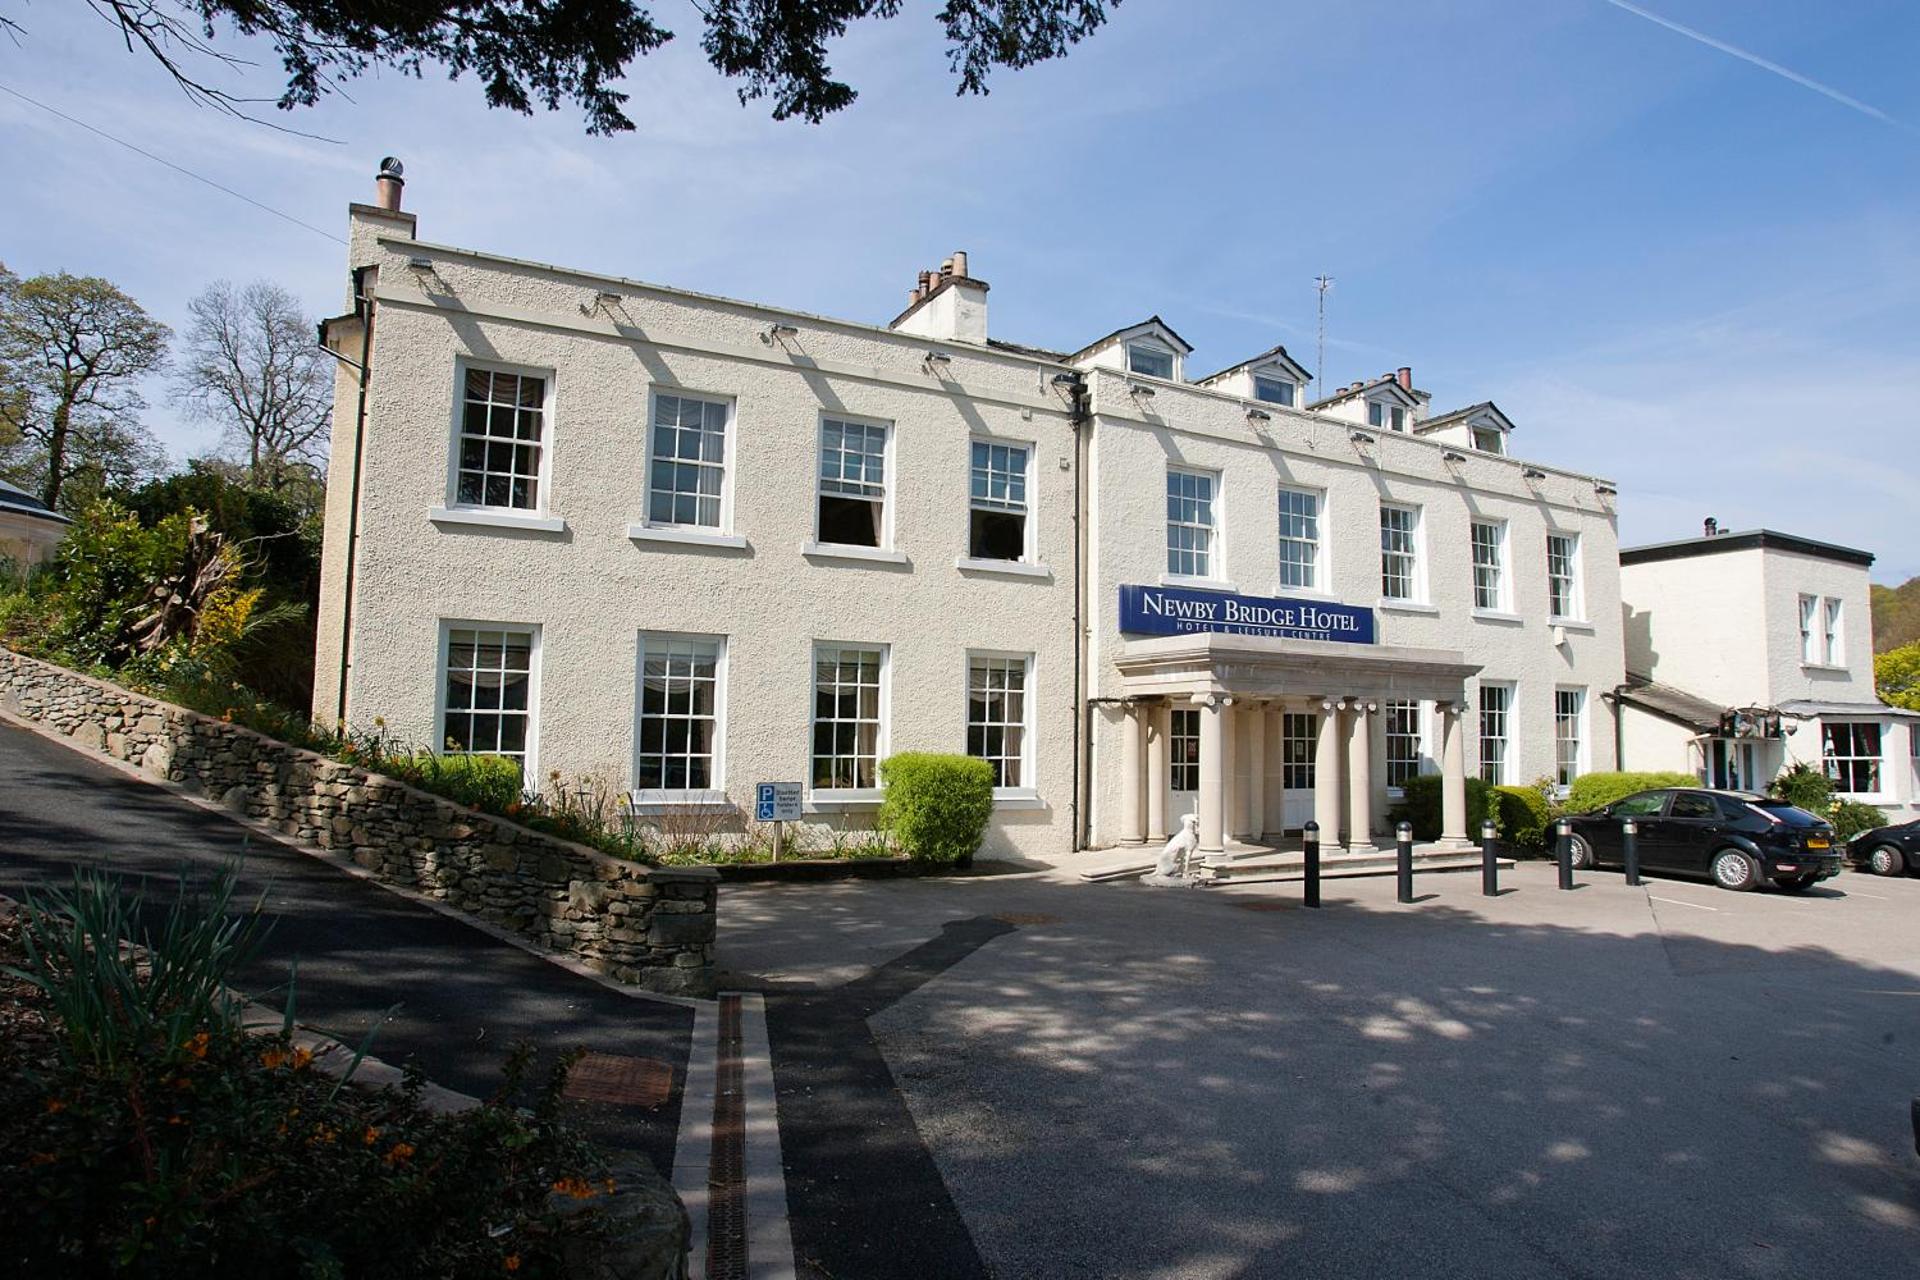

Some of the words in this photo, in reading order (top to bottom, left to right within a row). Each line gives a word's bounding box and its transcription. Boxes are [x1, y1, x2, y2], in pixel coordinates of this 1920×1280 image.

[1142, 592, 1217, 620] NEWBY
[1225, 600, 1295, 626] BRIDGE
[1299, 606, 1359, 631] HOTEL
[1177, 622, 1214, 633] HOTEL
[762, 787, 773, 801] P
